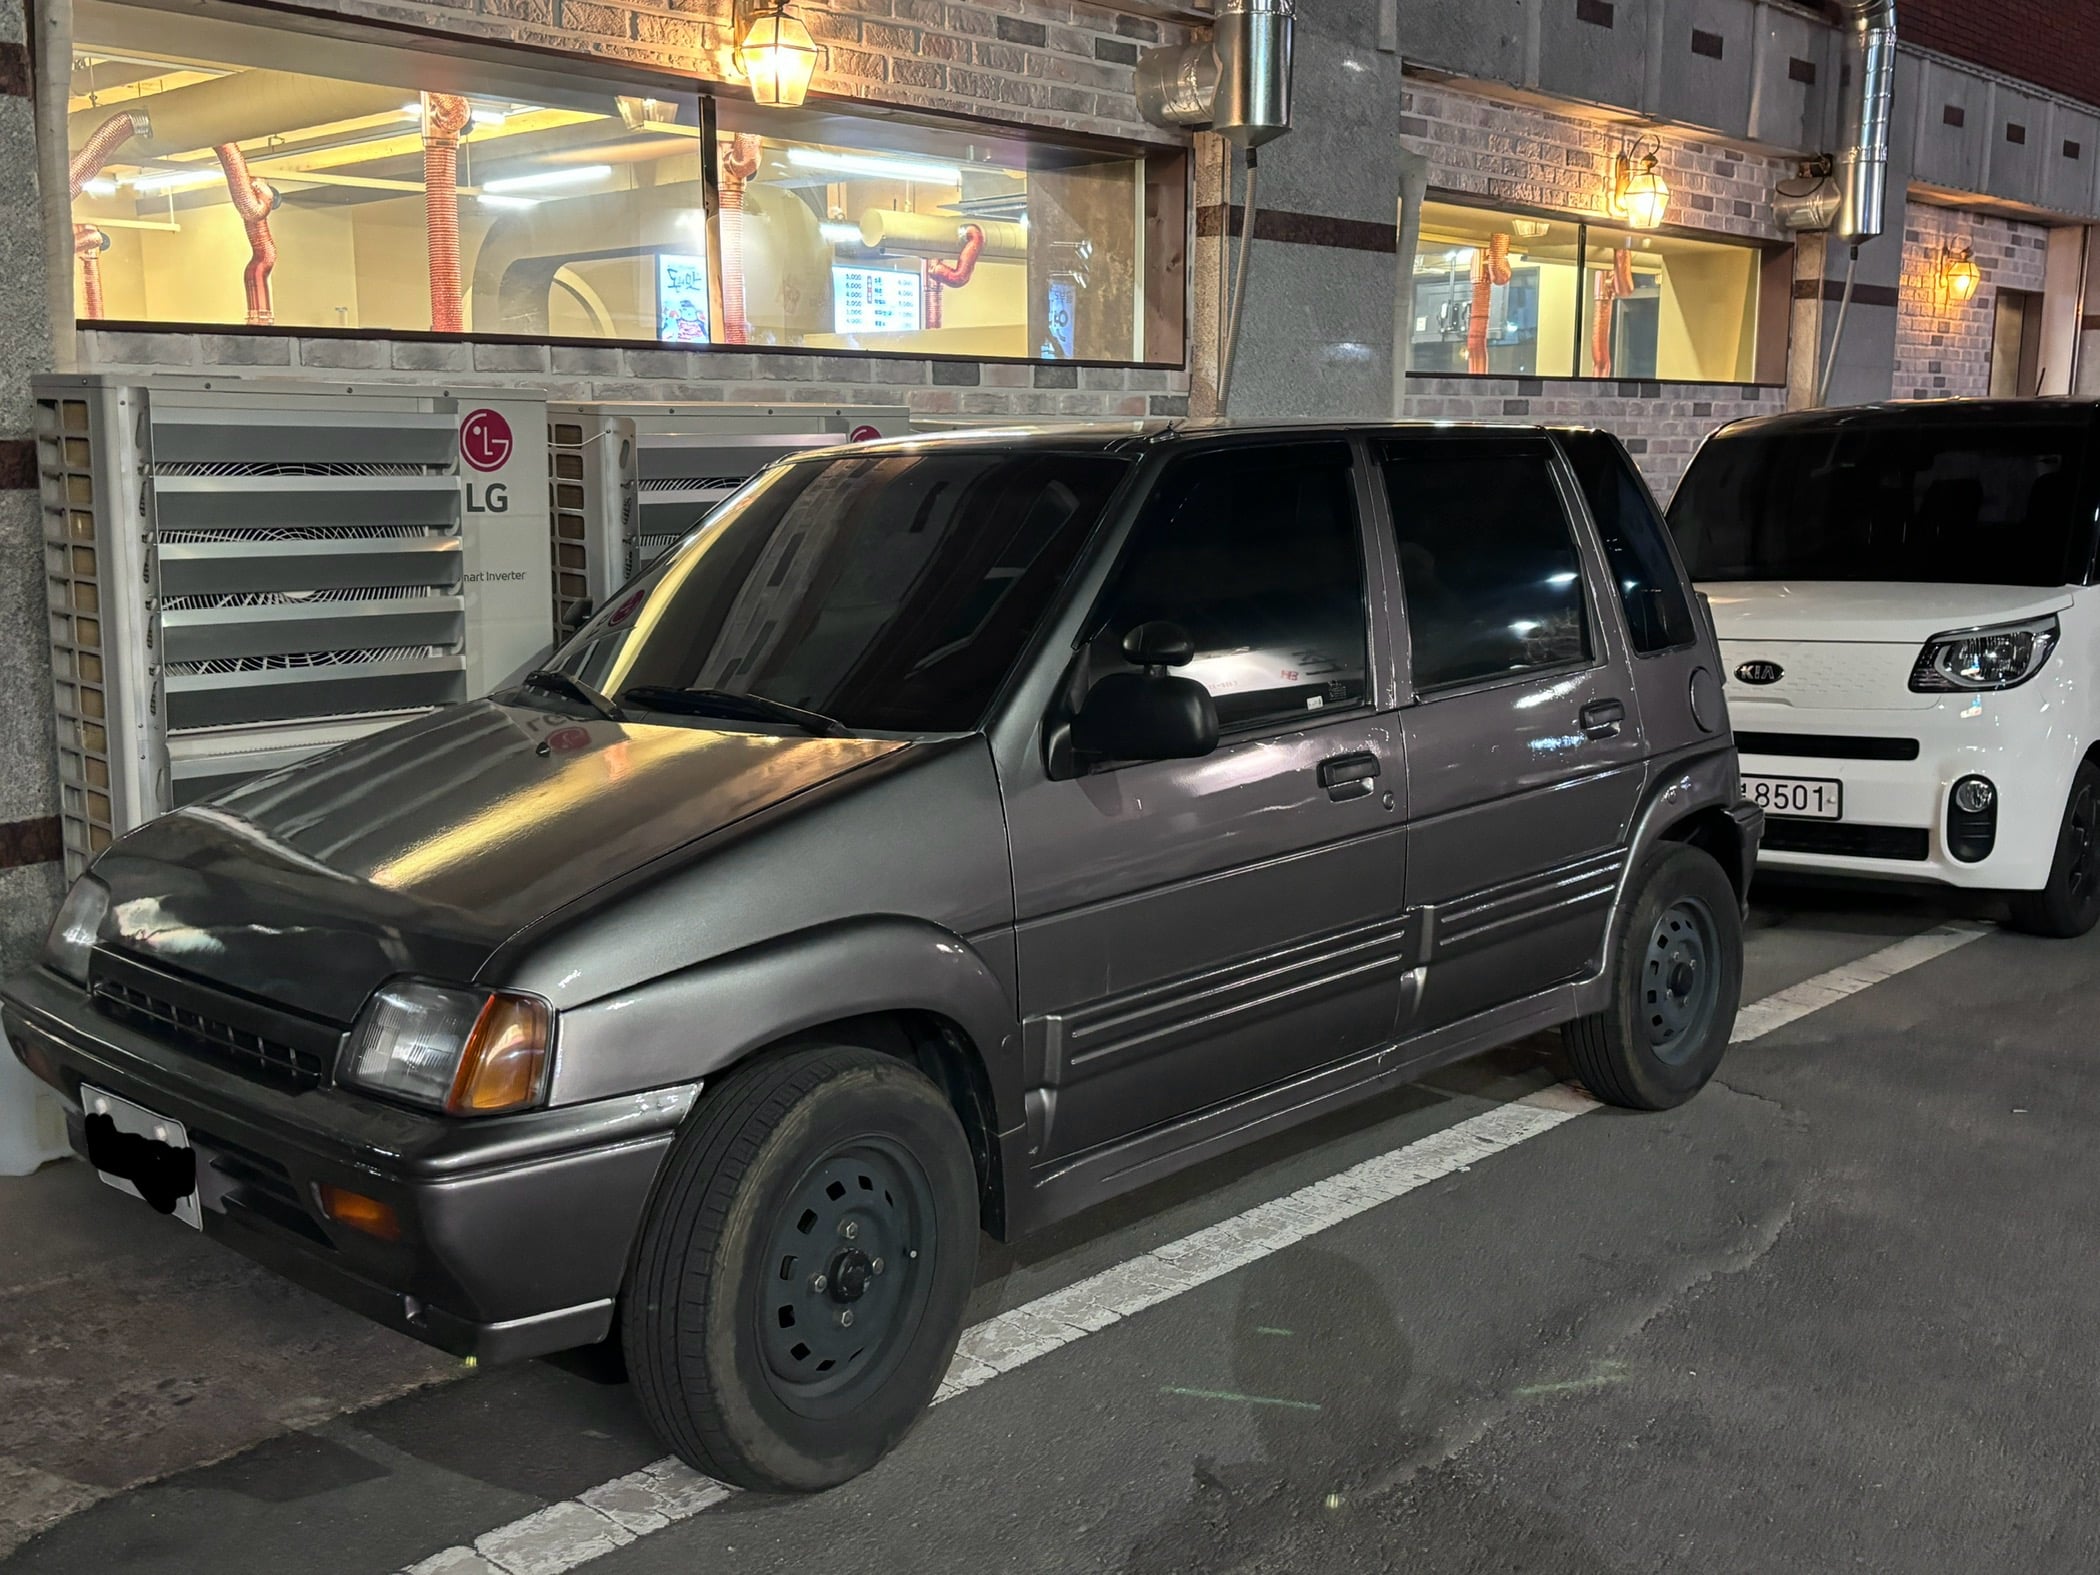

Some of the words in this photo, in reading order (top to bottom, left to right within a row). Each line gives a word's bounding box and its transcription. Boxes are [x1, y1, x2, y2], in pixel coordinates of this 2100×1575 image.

[466, 482, 508, 513] LG
[486, 570, 526, 581] Inverter
[1740, 665, 1775, 680] KIA
[1755, 783, 1823, 812] 8501
